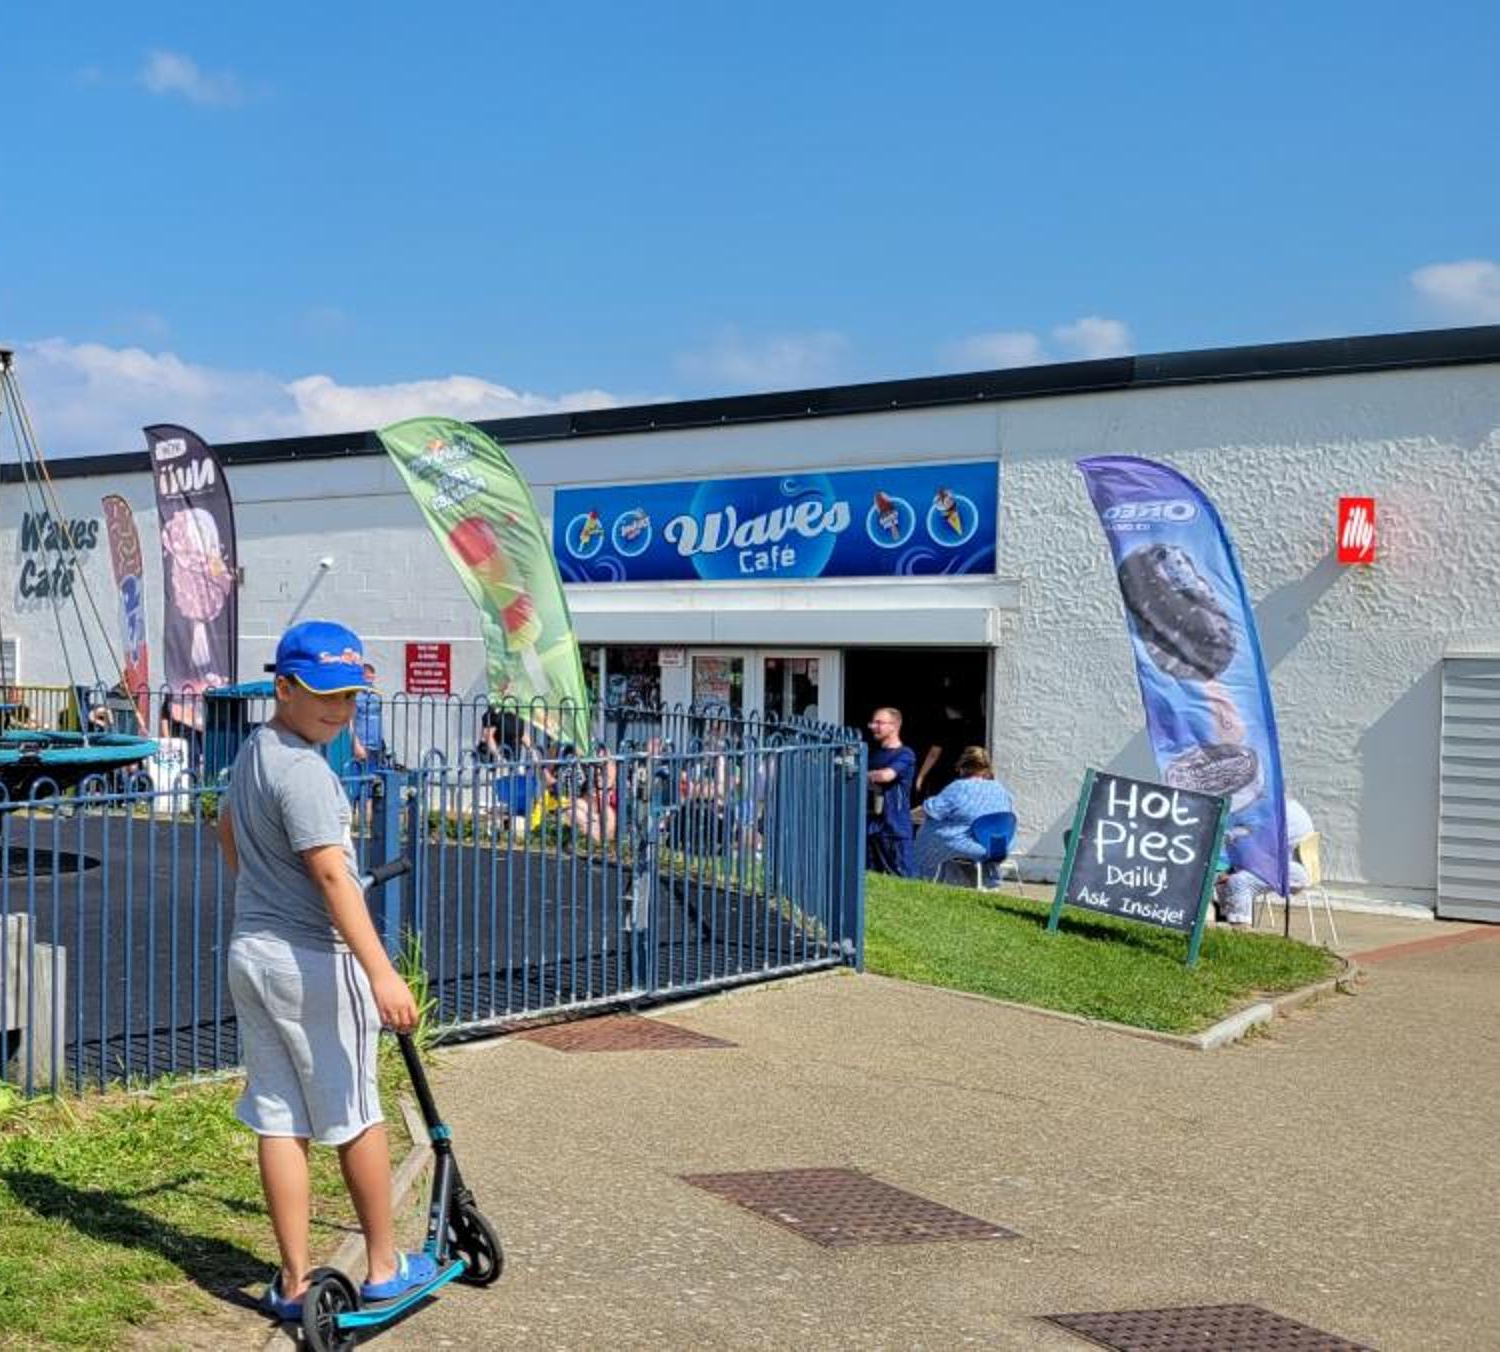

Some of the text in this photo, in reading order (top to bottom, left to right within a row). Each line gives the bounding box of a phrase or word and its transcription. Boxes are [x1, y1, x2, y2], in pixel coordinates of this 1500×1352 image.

[21, 511, 99, 552] Waves
[664, 501, 851, 557] Waves
[1342, 507, 1373, 558] illy
[20, 556, 76, 599] Café
[739, 543, 796, 573] Café
[1108, 780, 1199, 825] Hot
[1094, 820, 1196, 864] Pies
[1105, 864, 1168, 896] Daily!
[1077, 885, 1185, 924] Ask Inside!
